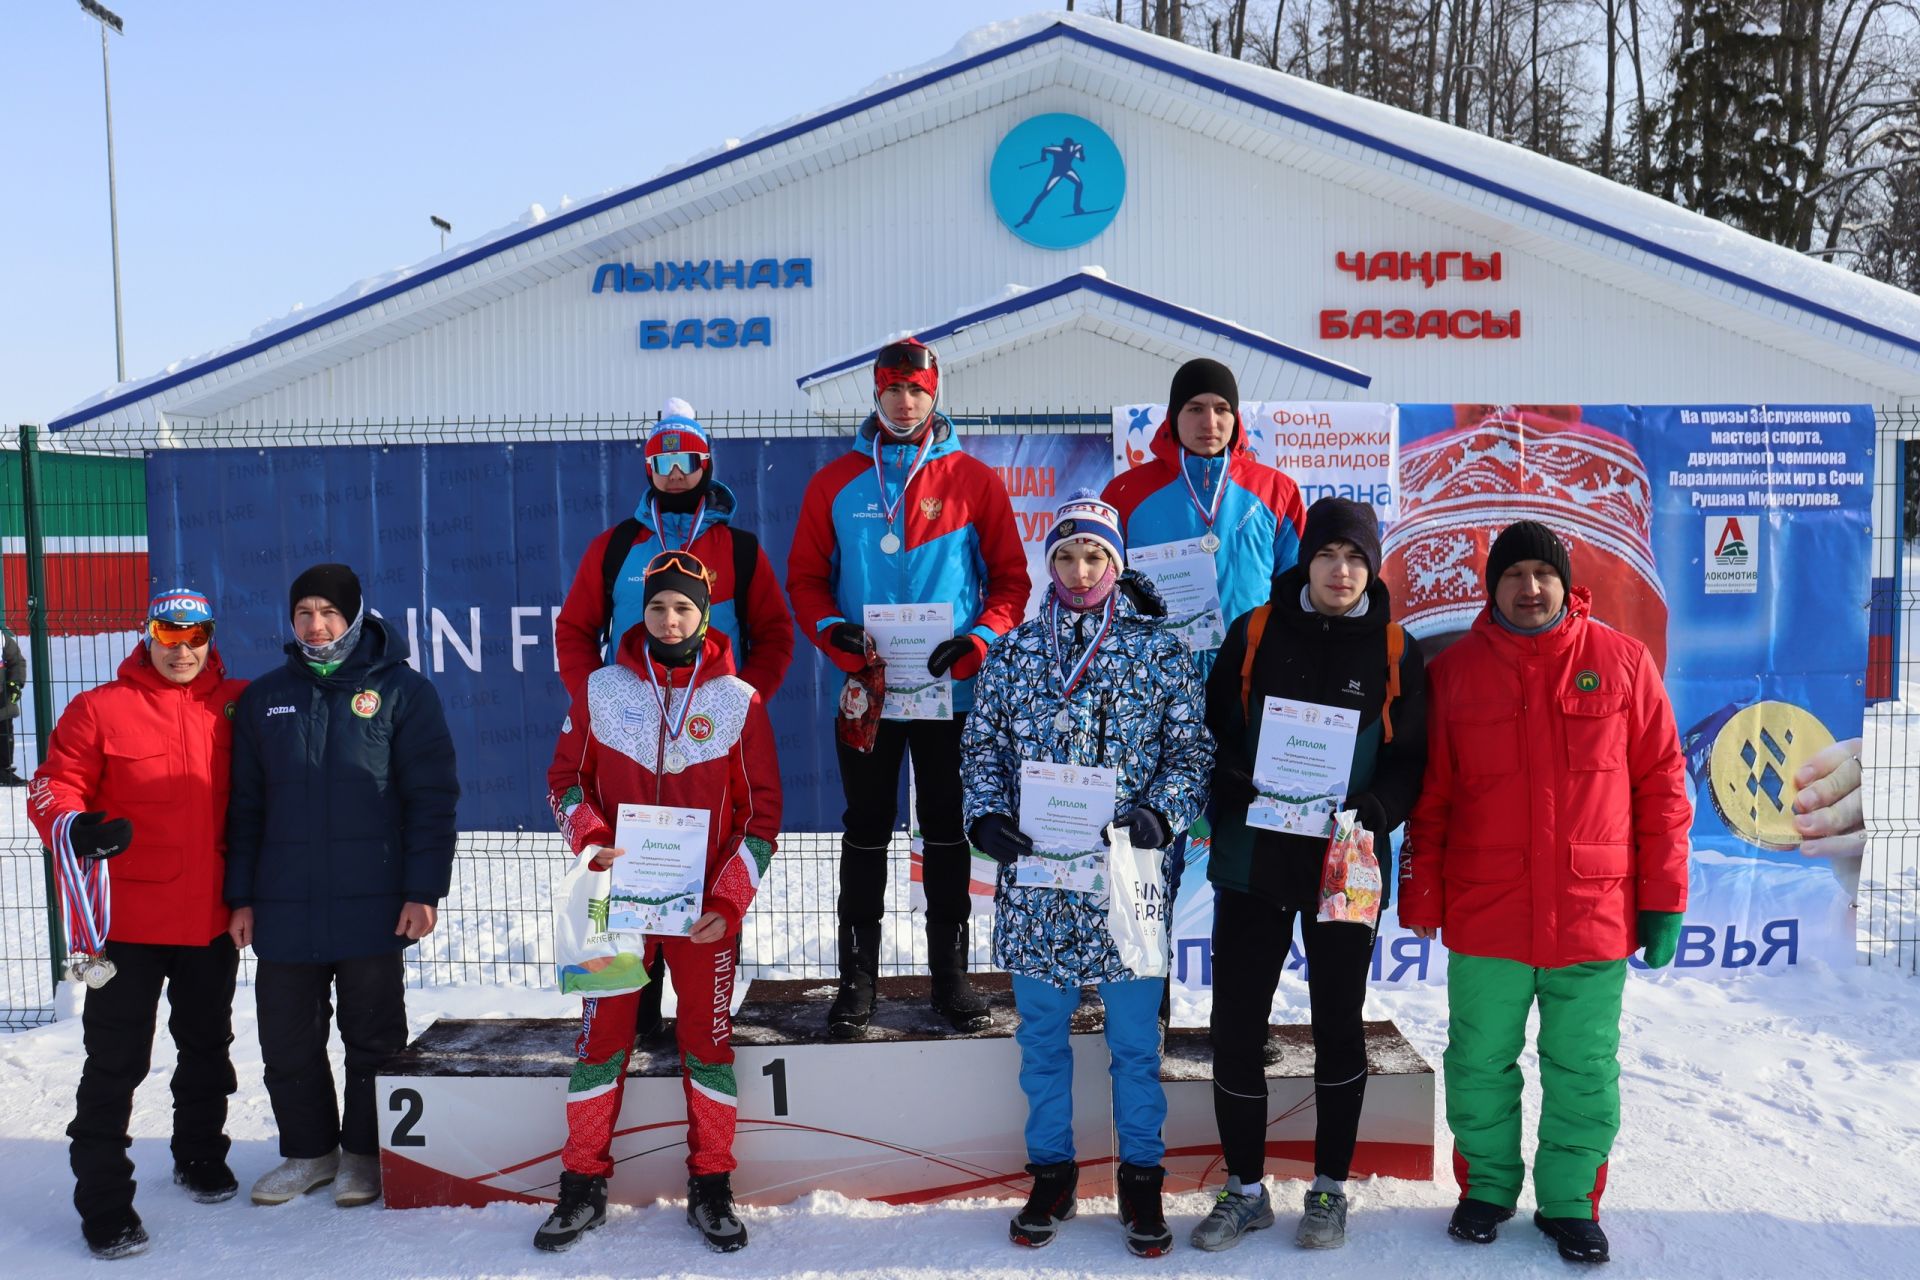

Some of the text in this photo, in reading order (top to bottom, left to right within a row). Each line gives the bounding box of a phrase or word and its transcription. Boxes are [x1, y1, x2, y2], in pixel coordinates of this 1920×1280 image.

[592, 257, 813, 294] ЛЫЖНАЯ
[1335, 251, 1502, 289] ЧАҢГЫ
[1319, 309, 1521, 340] БАЗАСЫ
[640, 317, 771, 350] БАЗА
[1273, 410, 1331, 428] Фонд
[1680, 409, 1851, 425] На призы Заслуженного
[1275, 431, 1390, 451] поддержки
[1711, 430, 1823, 446] мастера спорта,
[1276, 453, 1390, 471] инвалидов
[1687, 451, 1847, 467] двукратного чемпиона
[1669, 470, 1864, 487] Паралимпийских игр в Сочи
[1300, 483, 1392, 506] трана
[1691, 492, 1746, 507] Рушана
[1156, 570, 1191, 584] Диплом
[1705, 571, 1758, 580] ЛОКОМОТИВ
[154, 599, 208, 616] LUKOIL
[889, 635, 926, 647] Диплом
[1286, 735, 1327, 751] Диплом
[1047, 796, 1088, 810] Диплом
[642, 839, 681, 851] Диплом
[711, 949, 731, 1046] ТАТАРСТАН
[762, 1058, 788, 1116] 1
[388, 1088, 426, 1147] 2
